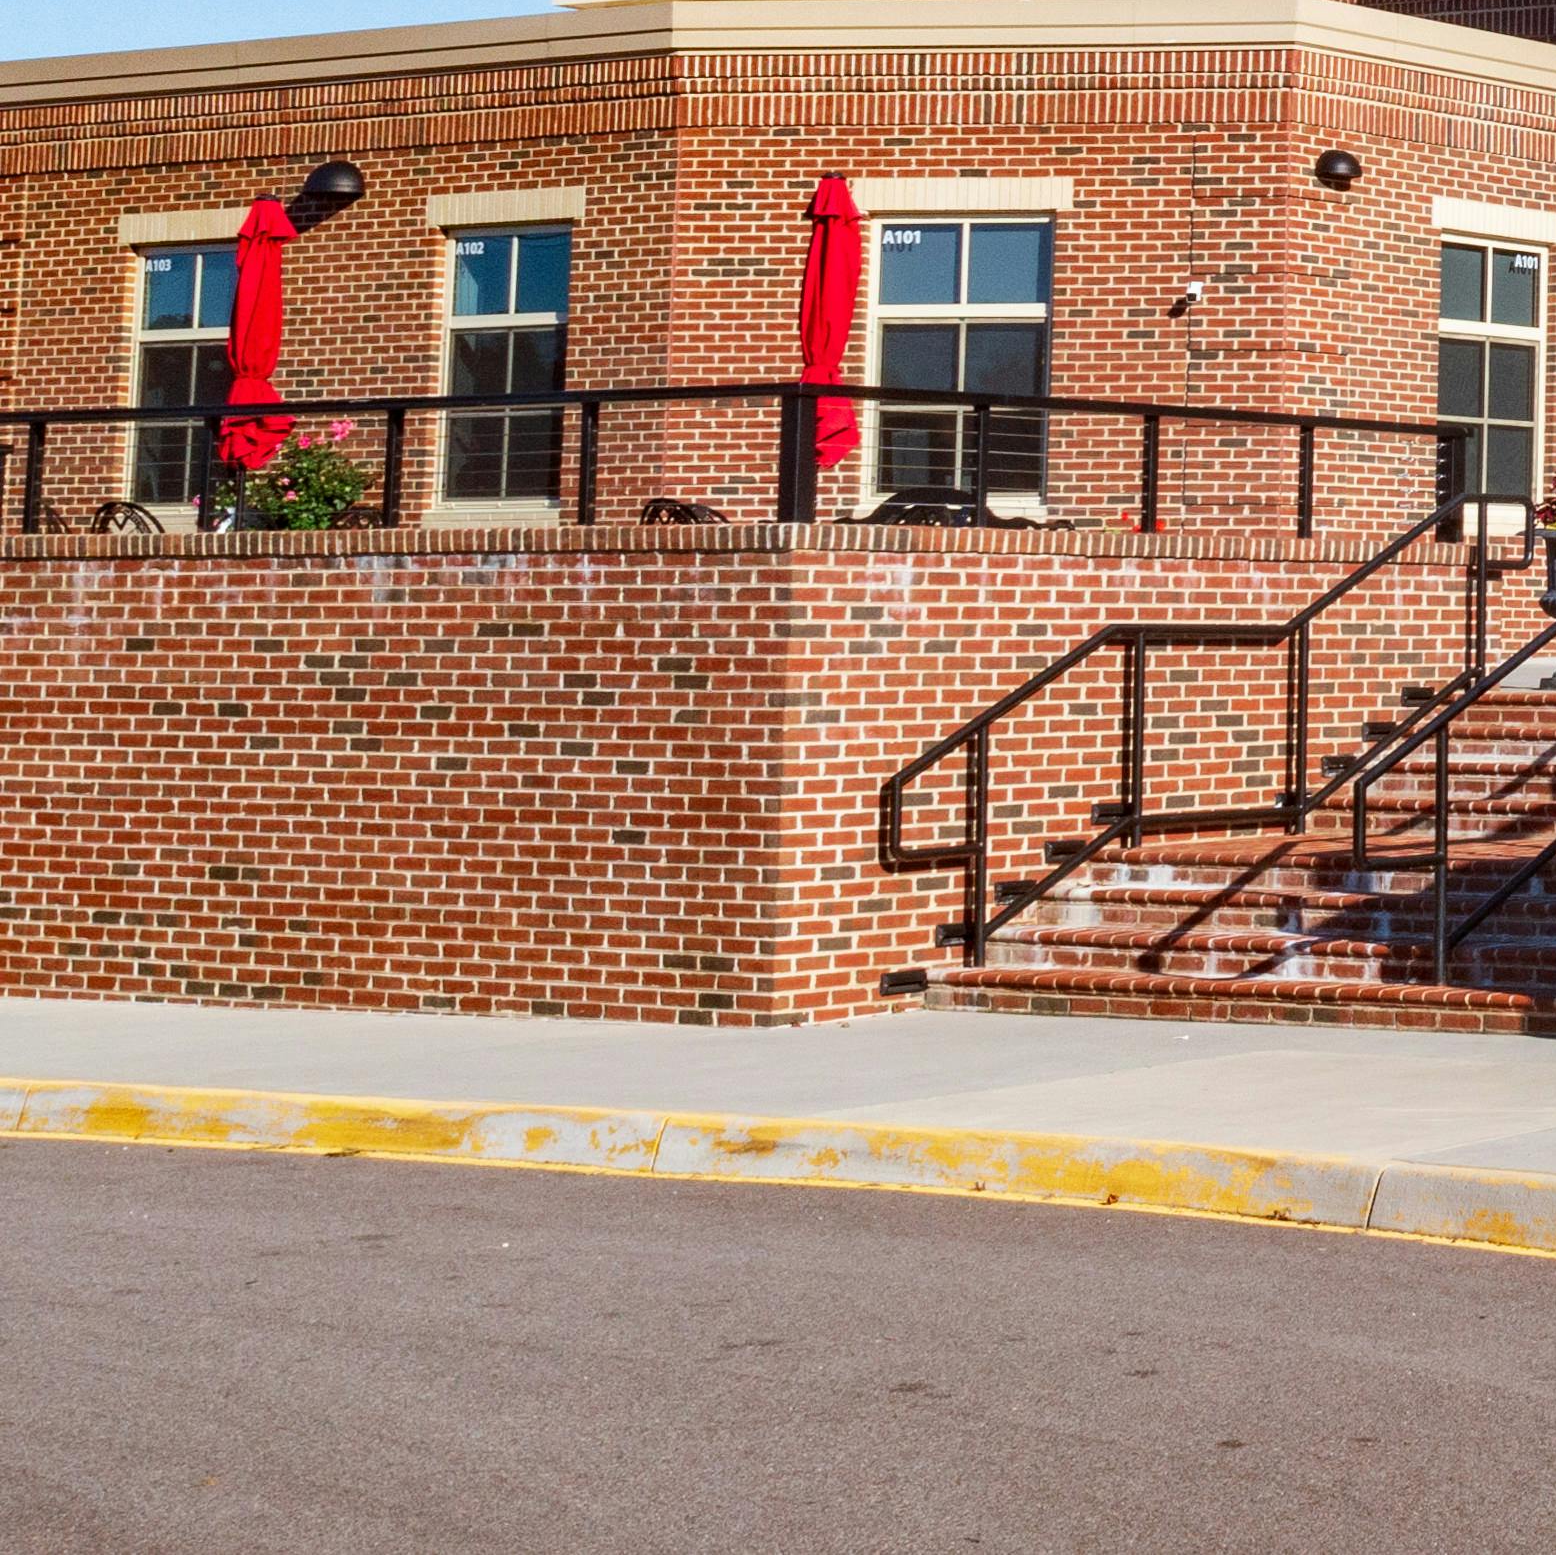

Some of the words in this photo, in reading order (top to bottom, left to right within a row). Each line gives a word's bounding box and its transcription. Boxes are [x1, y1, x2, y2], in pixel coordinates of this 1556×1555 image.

[883, 230, 921, 244] A101
[456, 241, 485, 255] A102
[145, 258, 172, 272] A103
[1514, 254, 1538, 269] A101
